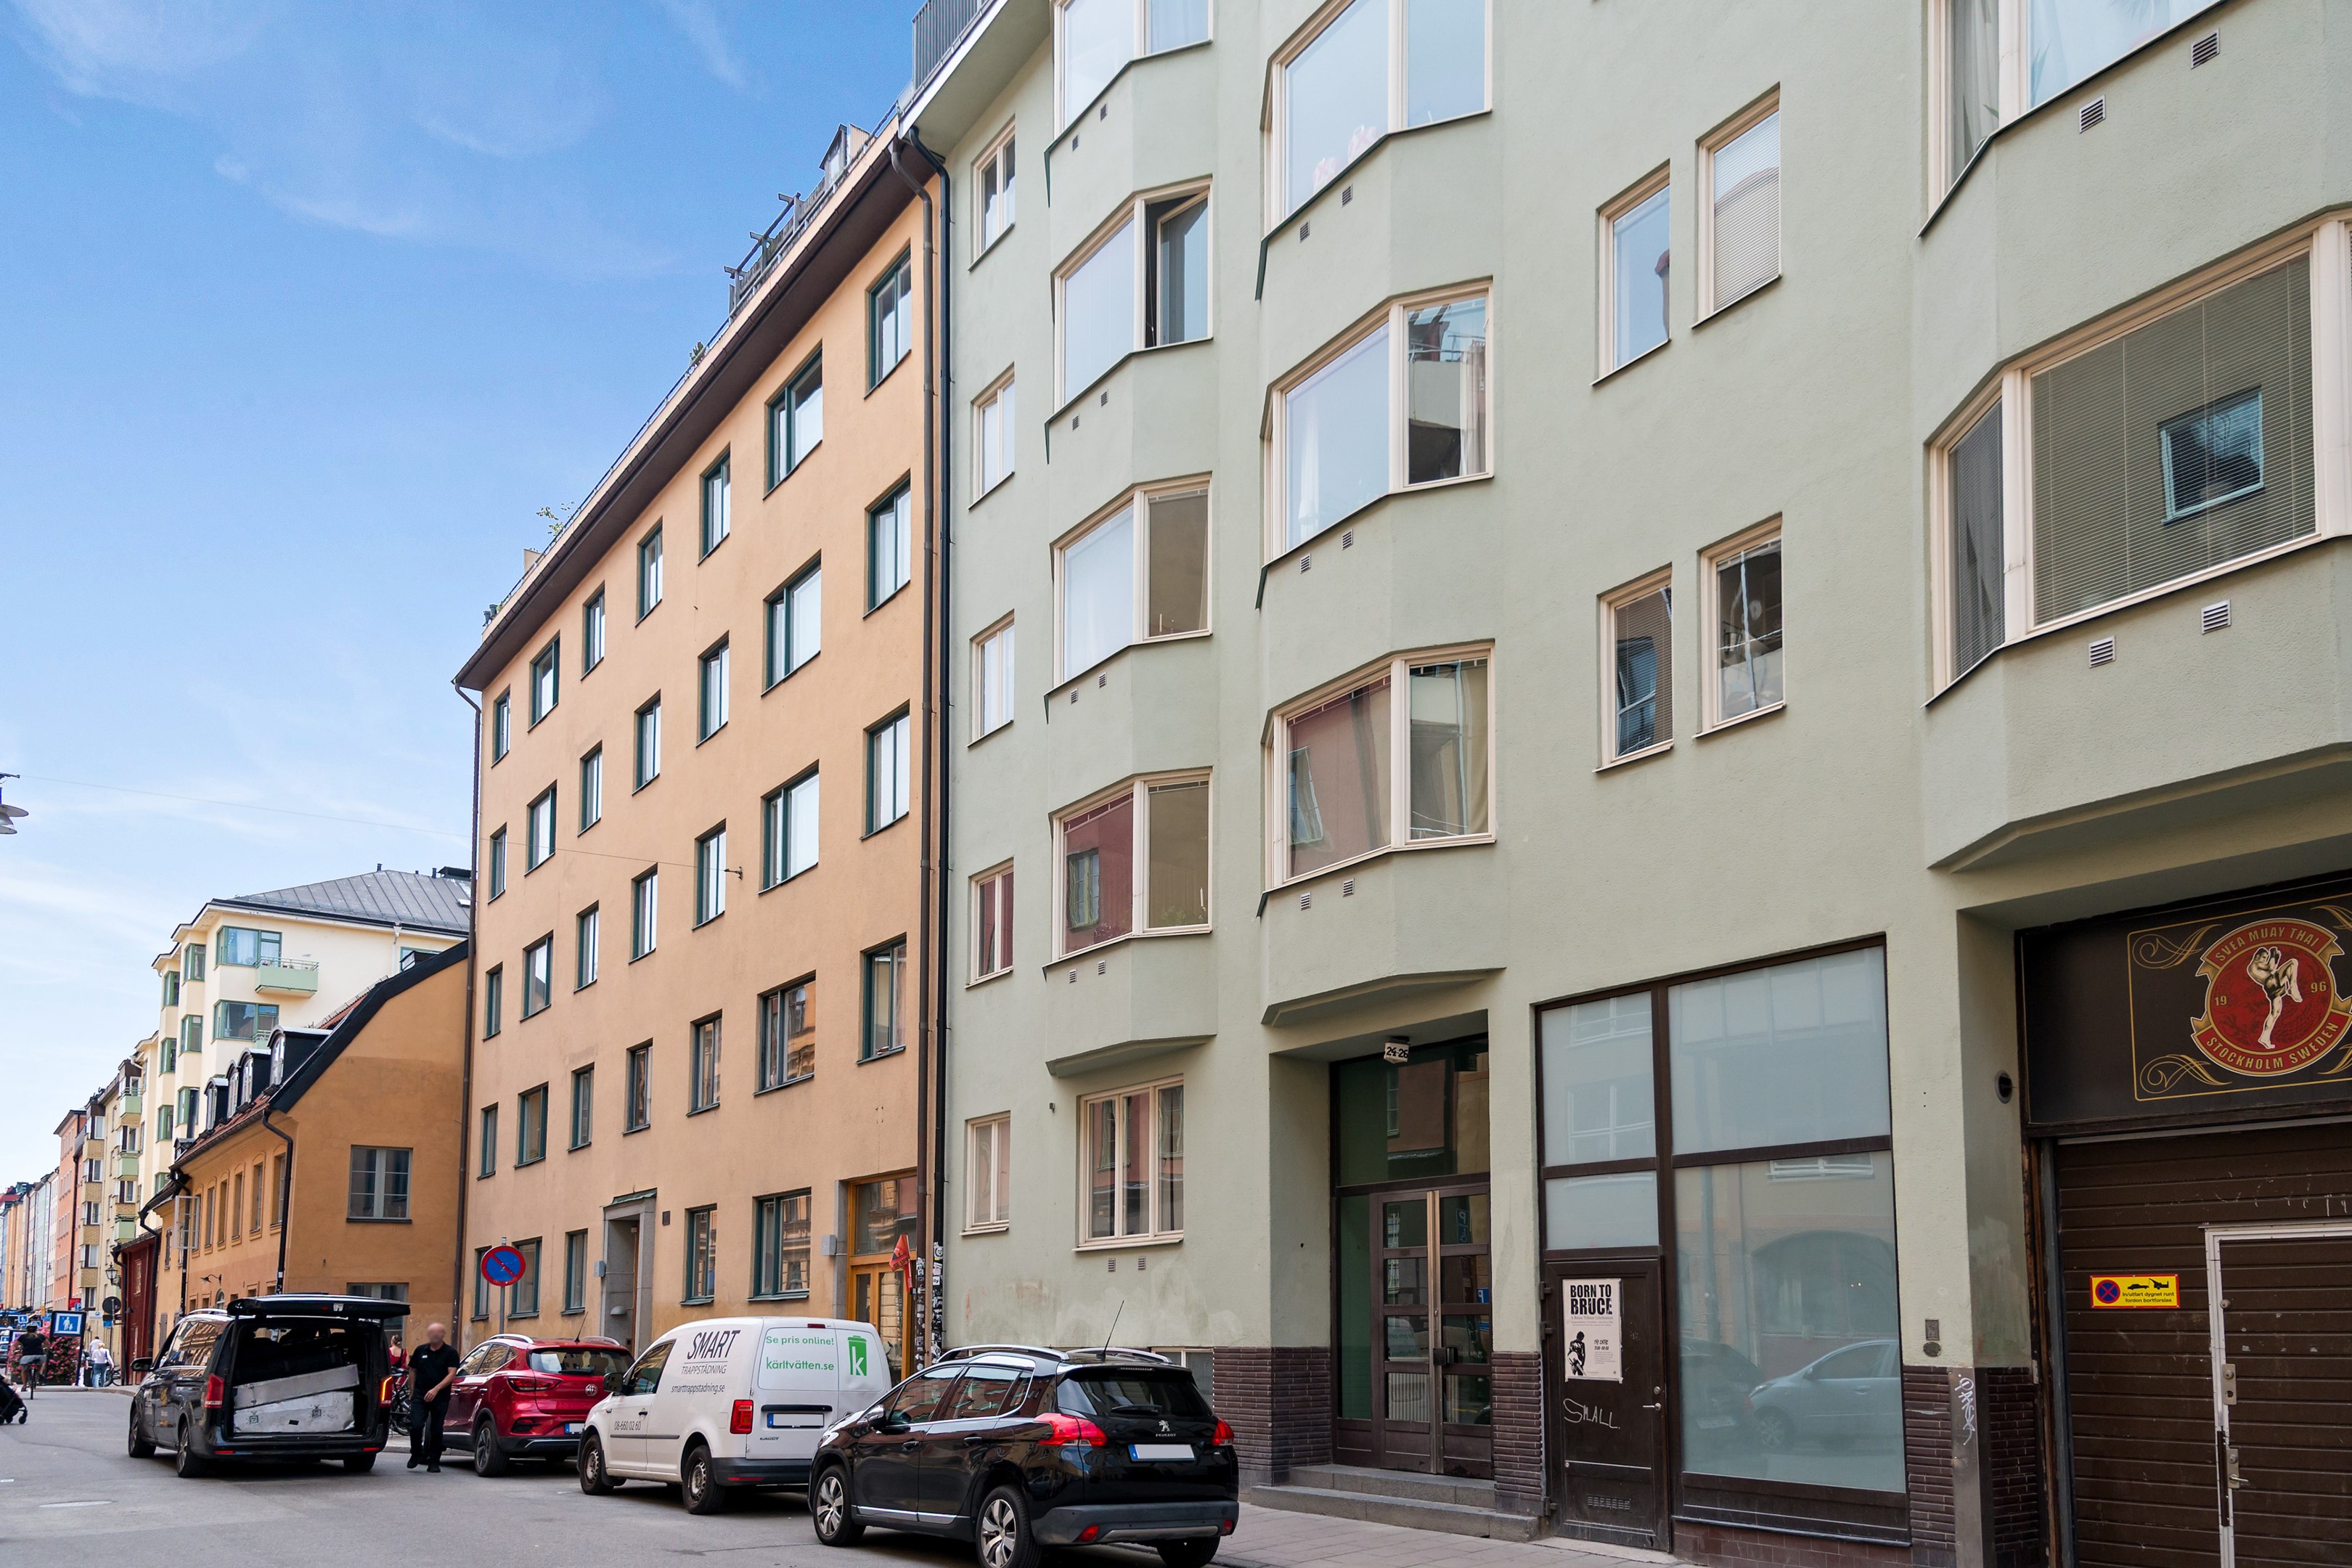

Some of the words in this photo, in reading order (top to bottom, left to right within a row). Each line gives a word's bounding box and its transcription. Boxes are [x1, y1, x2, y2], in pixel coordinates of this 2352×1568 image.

[2215, 936, 2245, 962] SVEA
[2248, 926, 2285, 942] MUAY
[2289, 928, 2321, 947] THAI
[2214, 995, 2227, 1006] 19
[2311, 981, 2327, 993] 96
[1386, 1046, 1408, 1058] 24-26
[2207, 1037, 2284, 1070] STOCKHOLM
[2289, 1022, 2340, 1064] SWEDEN
[1570, 1284, 1597, 1298] BORN
[1598, 1284, 1612, 1298] TO
[1570, 1297, 1613, 1315] BRUCE
[687, 1330, 741, 1360] SMART
[781, 1336, 800, 1345] pris
[802, 1336, 834, 1345] online!
[681, 1364, 727, 1375] TRAPPSTÄDNING
[766, 1357, 835, 1371] kärltvätten.se
[614, 1421, 629, 1431] 08-660
[629, 1421, 634, 1431] 02
[635, 1421, 642, 1431] 60
